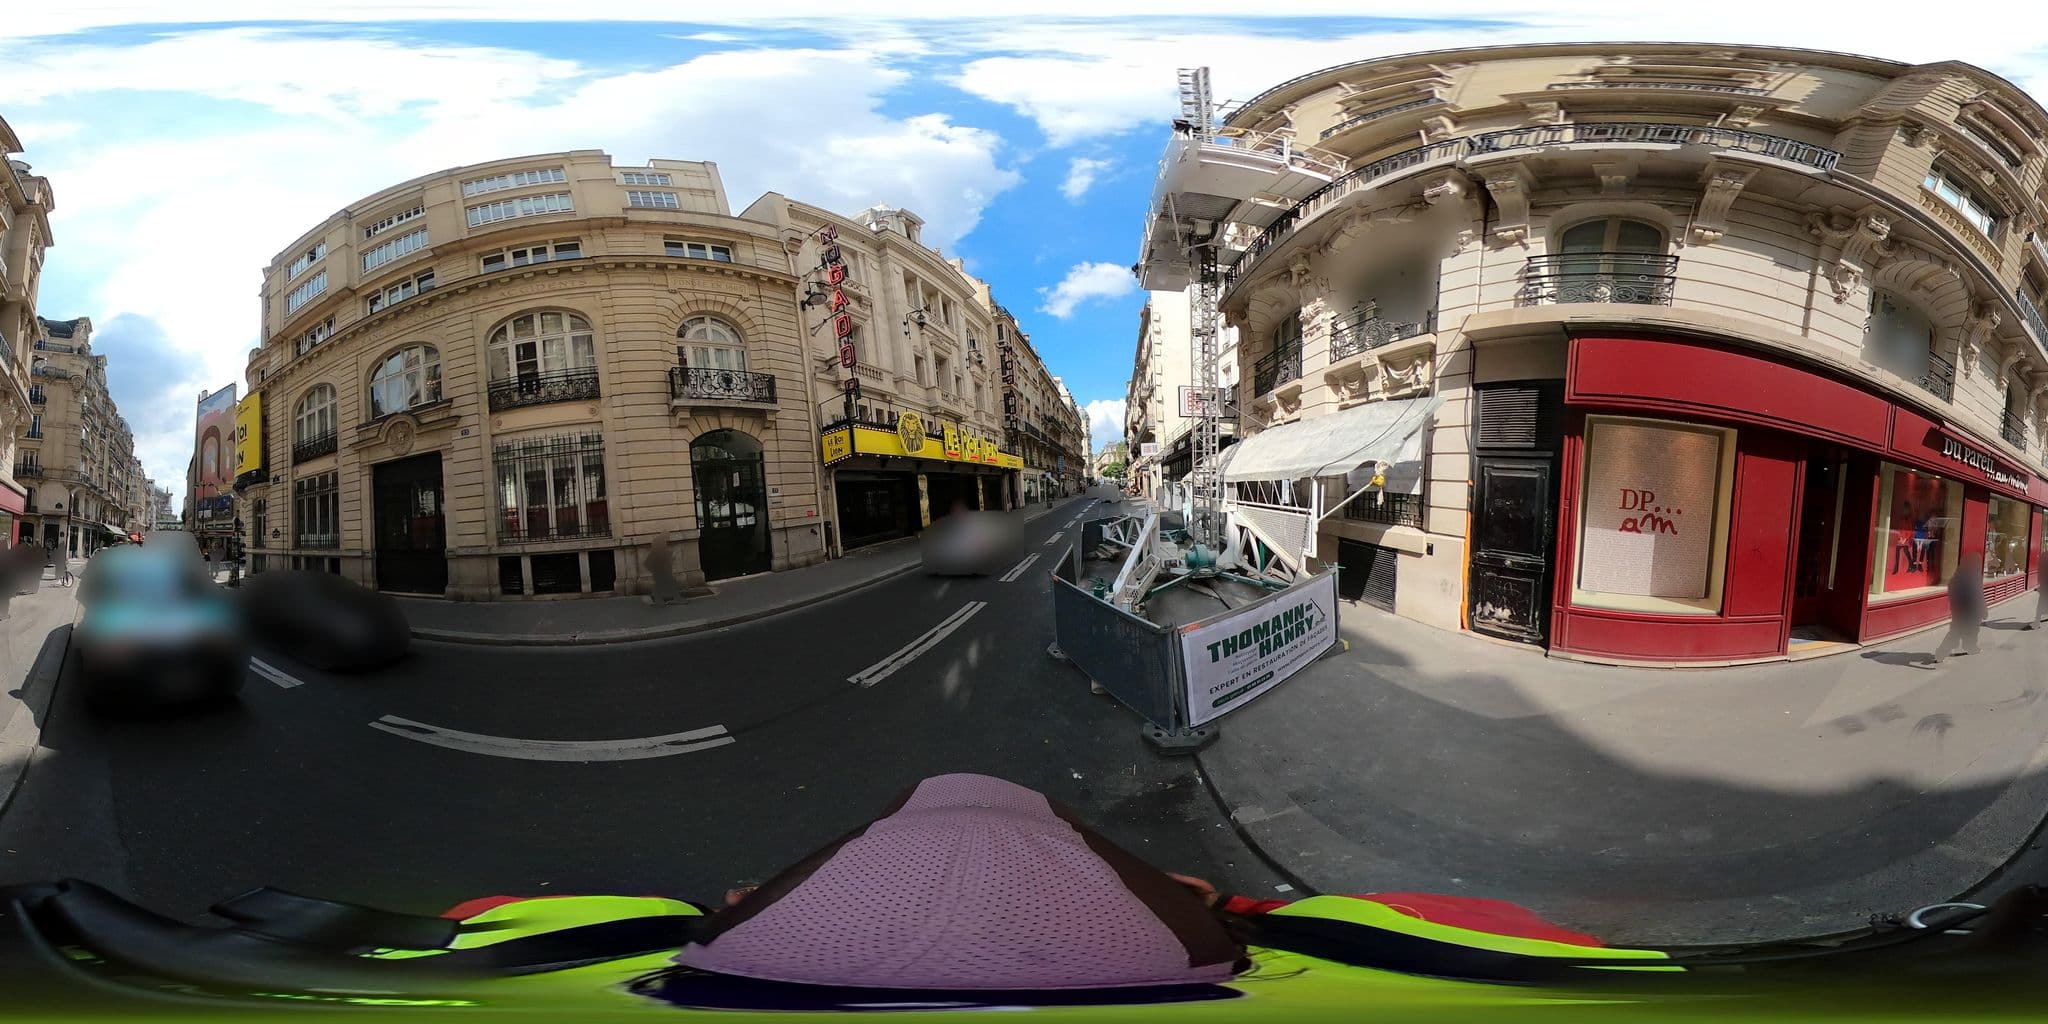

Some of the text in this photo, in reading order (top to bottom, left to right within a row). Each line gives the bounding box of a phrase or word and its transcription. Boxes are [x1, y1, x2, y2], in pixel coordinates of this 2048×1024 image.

[820, 224, 860, 400] MOGADOR
[1943, 437, 1962, 460] DU
[1619, 512, 1678, 535] am
[1206, 602, 1313, 663] THOMANN-
[1259, 614, 1314, 659] HANRY
[1209, 676, 1240, 695] EXPERT
[1241, 670, 1251, 680] EN
[1253, 643, 1299, 674] RESTAURATION
